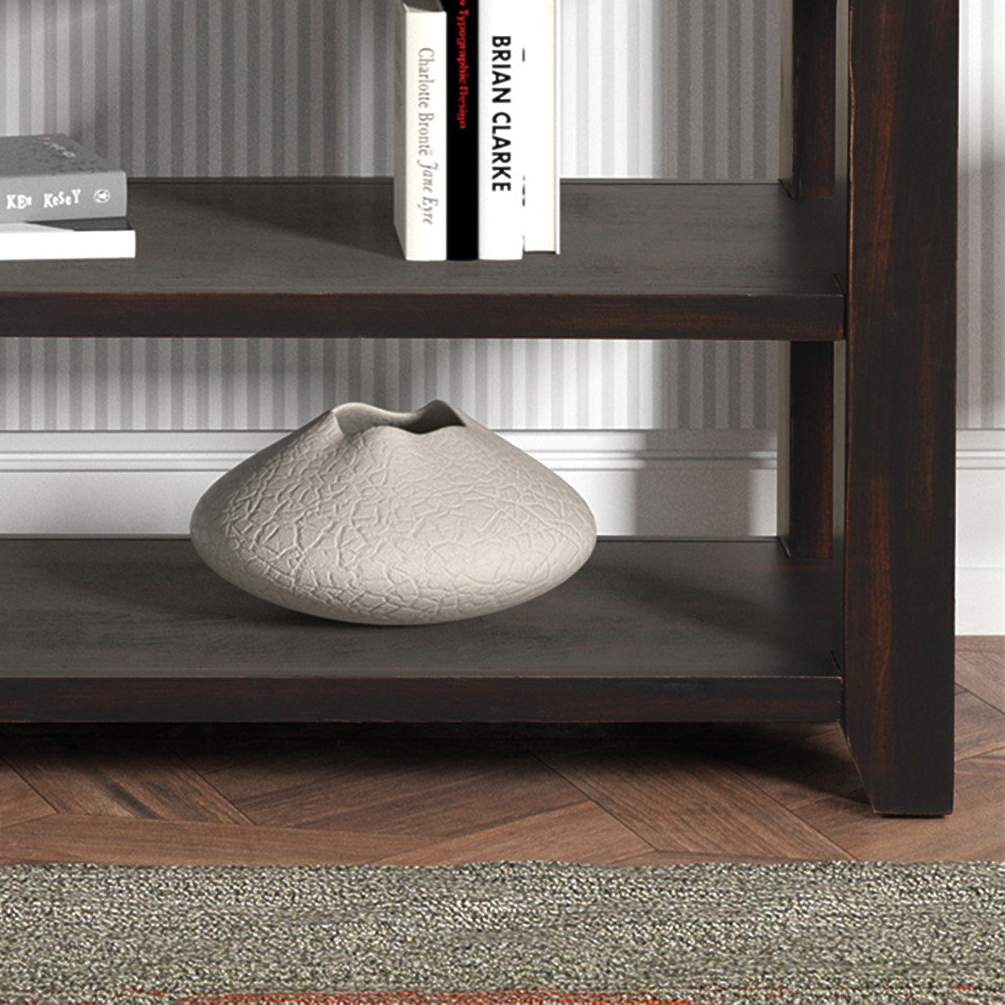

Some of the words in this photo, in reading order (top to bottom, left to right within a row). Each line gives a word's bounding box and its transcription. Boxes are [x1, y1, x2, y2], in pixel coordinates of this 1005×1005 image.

[456, 8, 470, 84] Typographic
[491, 35, 512, 103] BRIAN
[417, 47, 435, 108] Charlotte
[456, 85, 470, 129] Design
[417, 112, 435, 156] Brontë
[491, 111, 512, 192] CLARKE
[416, 159, 439, 193] Jane
[416, 196, 439, 225] Eyre
